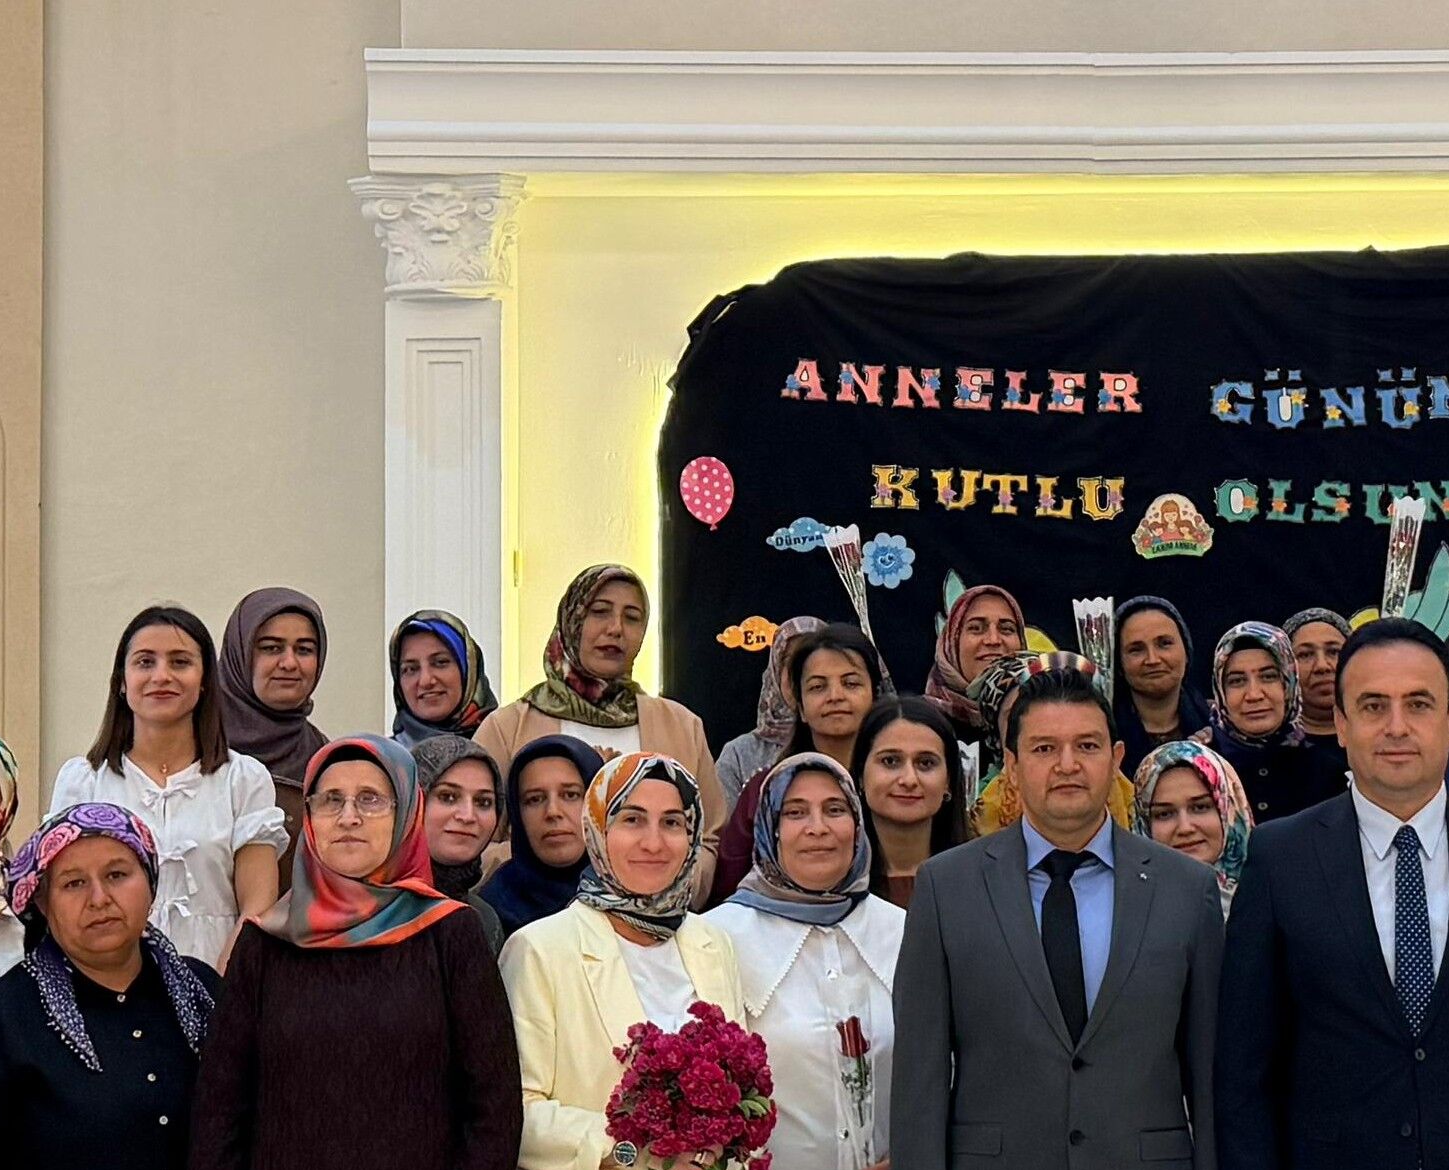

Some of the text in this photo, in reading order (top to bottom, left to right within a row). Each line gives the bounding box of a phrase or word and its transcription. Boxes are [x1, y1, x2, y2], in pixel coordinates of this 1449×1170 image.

[781, 357, 1142, 414] ANNELER
[870, 464, 1126, 521] KUTLU
[743, 631, 766, 645] En
